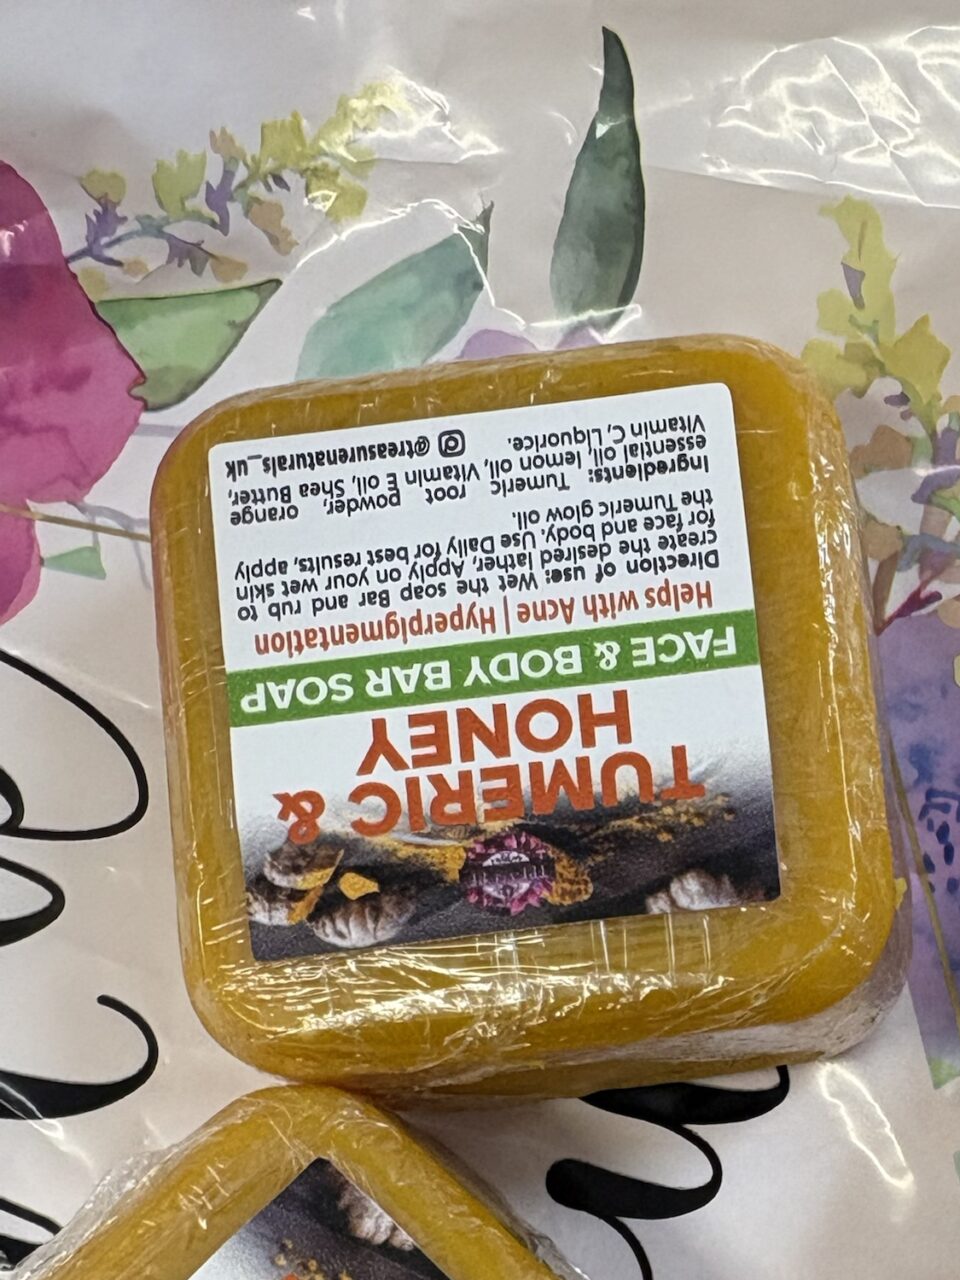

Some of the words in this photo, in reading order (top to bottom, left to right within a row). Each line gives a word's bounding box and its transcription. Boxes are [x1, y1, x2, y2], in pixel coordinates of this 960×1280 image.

[607, 423, 625, 442] C,
[629, 414, 705, 439] Vitamin
[224, 435, 430, 481] @treasurenaturals_uk
[519, 450, 581, 470] lemon
[587, 443, 616, 466] oil,
[623, 434, 706, 462] essential
[386, 472, 398, 490] E
[404, 462, 479, 486] Vitamin
[483, 458, 512, 478] oil,
[587, 452, 708, 483] Ingredients:
[227, 484, 291, 507] Butter,
[298, 478, 344, 497] Shea
[351, 474, 379, 494] oil,
[424, 483, 465, 504] root
[489, 472, 569, 497] Tumeric
[229, 498, 298, 525] orange
[322, 486, 400, 515] powder,
[581, 589, 639, 622] with
[643, 577, 712, 611] Helps
[516, 596, 574, 624] Acne
[254, 600, 495, 658] Hyperpigmentation
[593, 640, 620, 670] &
[629, 625, 736, 666] FACE
[364, 659, 450, 697] BAR
[463, 644, 582, 686] BODY
[240, 672, 353, 712] SOAP
[357, 688, 631, 776] HONEY
[348, 743, 706, 839] TUMERIC
[275, 788, 325, 846] &
